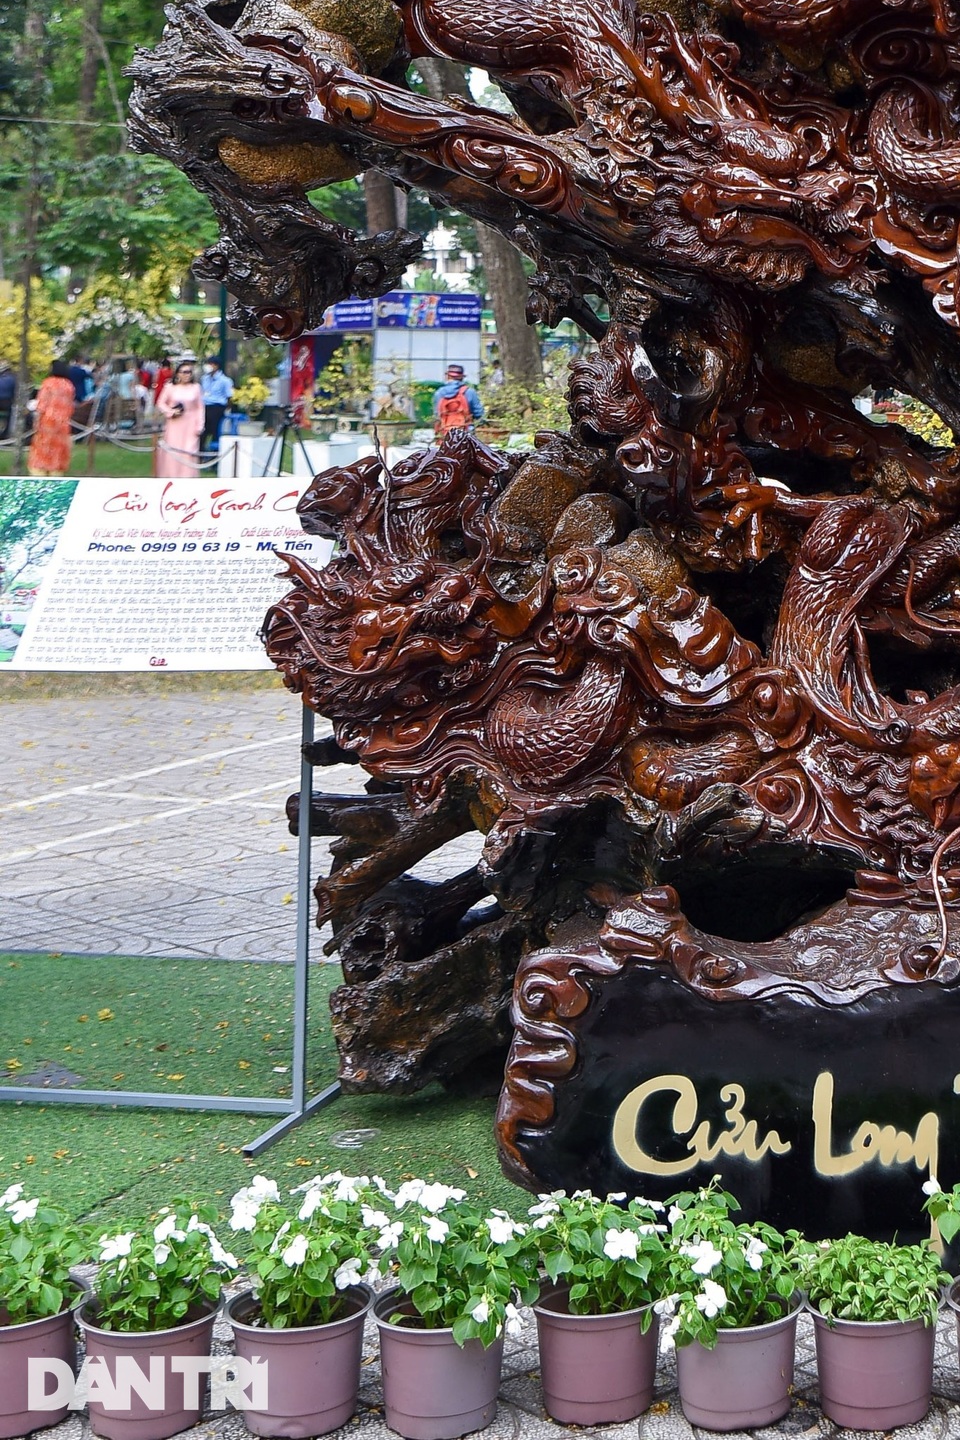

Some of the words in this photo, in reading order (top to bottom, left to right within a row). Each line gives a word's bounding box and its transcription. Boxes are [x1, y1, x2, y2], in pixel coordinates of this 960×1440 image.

[211, 489, 267, 519] Tranh
[88, 542, 136, 553] Phone:
[141, 542, 177, 553] 0919
[182, 542, 197, 552] 19
[202, 542, 220, 552] 63
[225, 542, 241, 552] 19
[284, 540, 313, 551] Tiến
[612, 1073, 793, 1176] Cửu
[812, 1070, 940, 1215] Long
